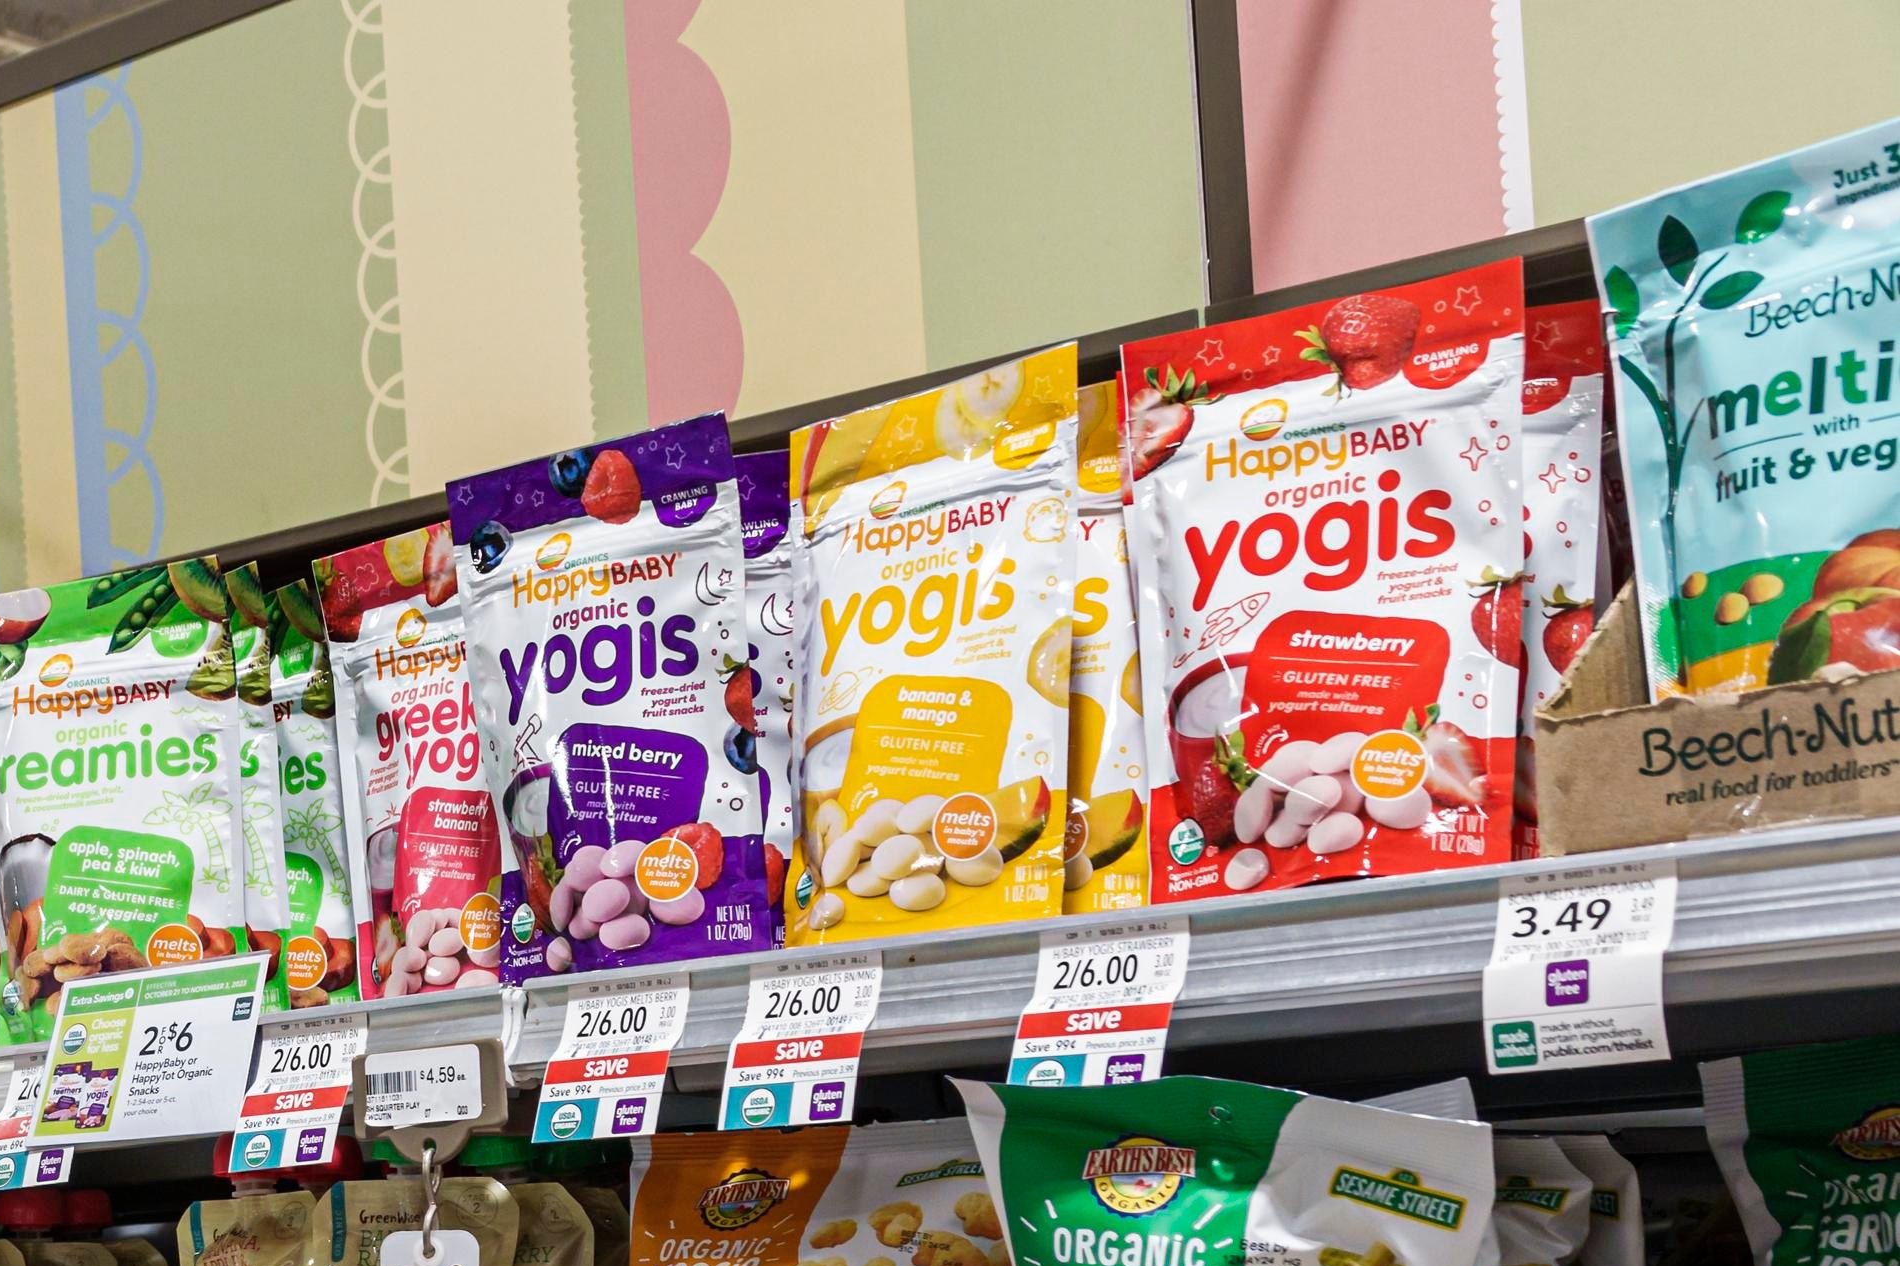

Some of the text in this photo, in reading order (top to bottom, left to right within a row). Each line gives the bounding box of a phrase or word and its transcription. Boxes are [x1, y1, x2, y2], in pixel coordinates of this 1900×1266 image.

[1413, 343, 1479, 366] CRAWLING
[1814, 416, 1859, 437] with
[1206, 420, 1430, 482] HappyBABY
[1266, 472, 1366, 507] organic
[1716, 457, 1776, 501] fruit
[1186, 470, 1455, 611] yogis
[881, 548, 957, 581] organic
[553, 600, 628, 630] organic
[821, 544, 1017, 677] yogis
[1289, 631, 1415, 655] strawberry
[501, 596, 697, 725] yogis
[898, 687, 956, 704] banana
[903, 708, 957, 726] mango
[572, 741, 682, 769] mixed berry
[1360, 748, 1421, 766] melts
[1666, 786, 1704, 807] real
[1712, 781, 1758, 798] food
[1766, 774, 1796, 791] for
[434, 818, 478, 831] banana
[942, 811, 991, 828] melts
[1511, 899, 1611, 939] 3.49
[1053, 954, 1138, 989] 2/6.00
[765, 986, 840, 1019] 2/6.00
[576, 1006, 647, 1038] 2/6.00
[1065, 1011, 1121, 1032] save
[774, 1038, 822, 1061] save
[132, 1069, 212, 1084] HappyTot Organic
[134, 1057, 197, 1071] HappyBaby or
[584, 1056, 628, 1077] save
[129, 1086, 159, 1096] Snacks
[813, 1089, 842, 1100] gluten
[1335, 1174, 1460, 1224] SESAME STREET
